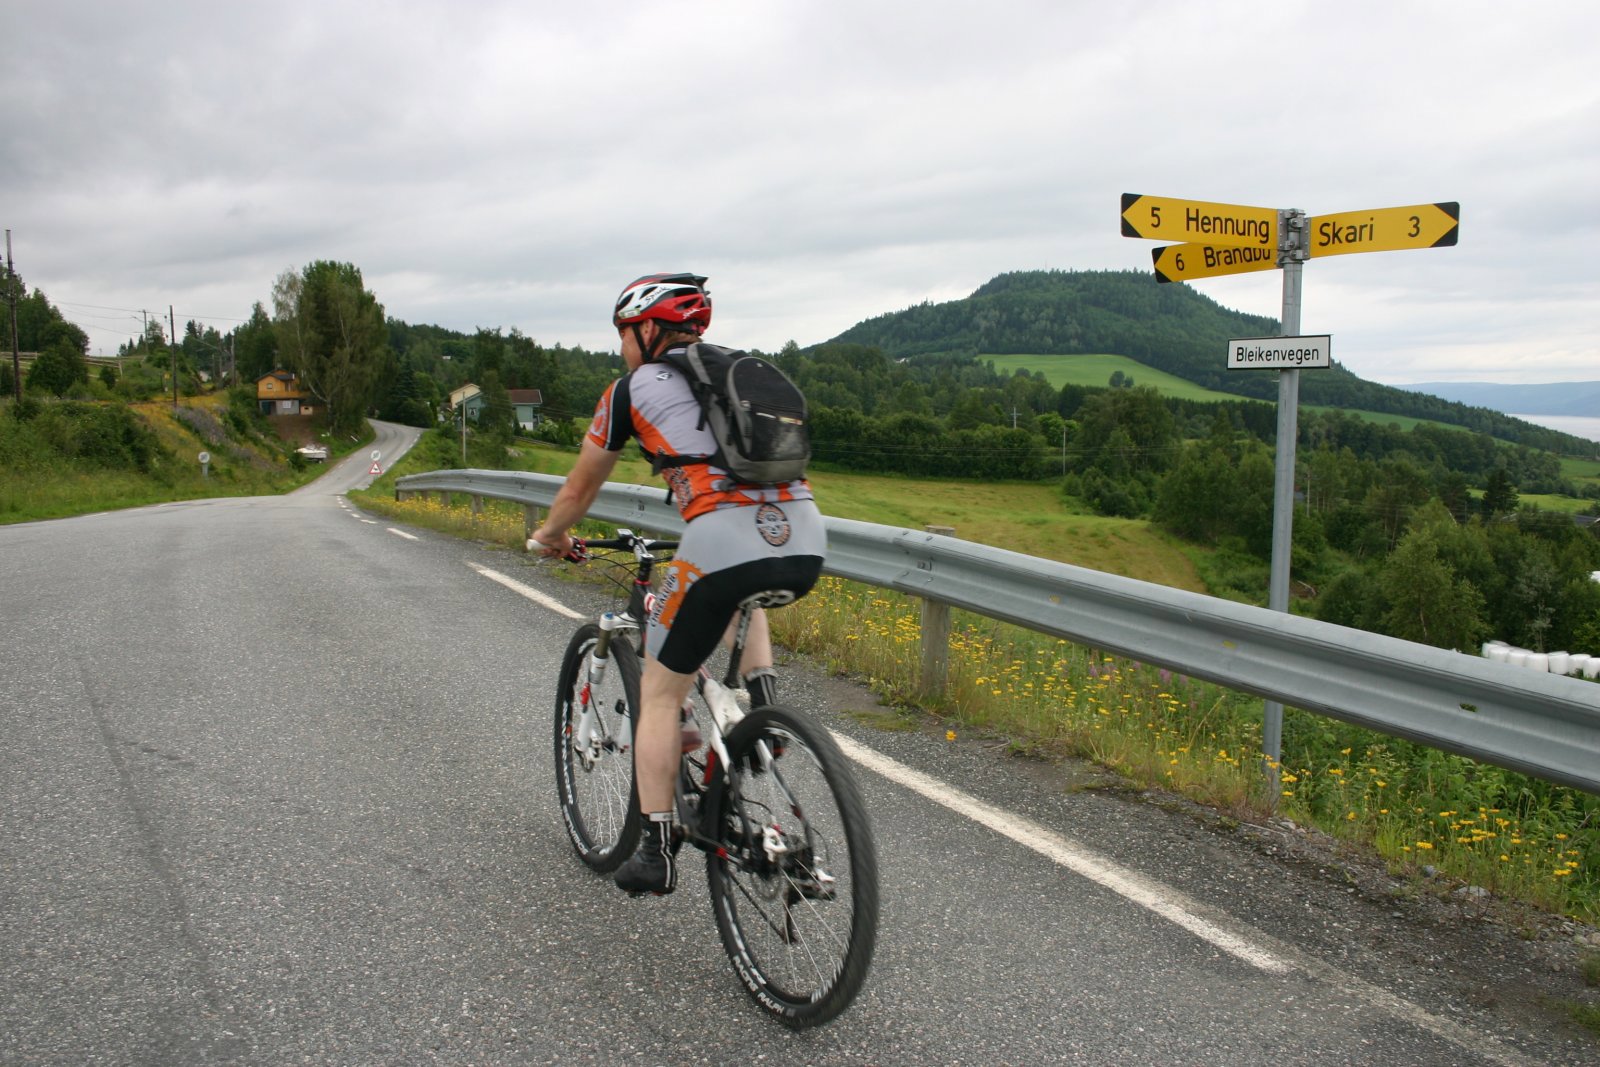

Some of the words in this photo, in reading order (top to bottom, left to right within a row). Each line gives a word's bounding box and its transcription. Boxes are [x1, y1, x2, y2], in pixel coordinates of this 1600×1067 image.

[1150, 206, 1161, 228] 5
[1185, 207, 1270, 244] Hennung
[1318, 217, 1374, 247] Skari
[1407, 215, 1421, 238] 3
[1175, 253, 1185, 271] 6
[1236, 346, 1319, 365] Bleikenvegen
